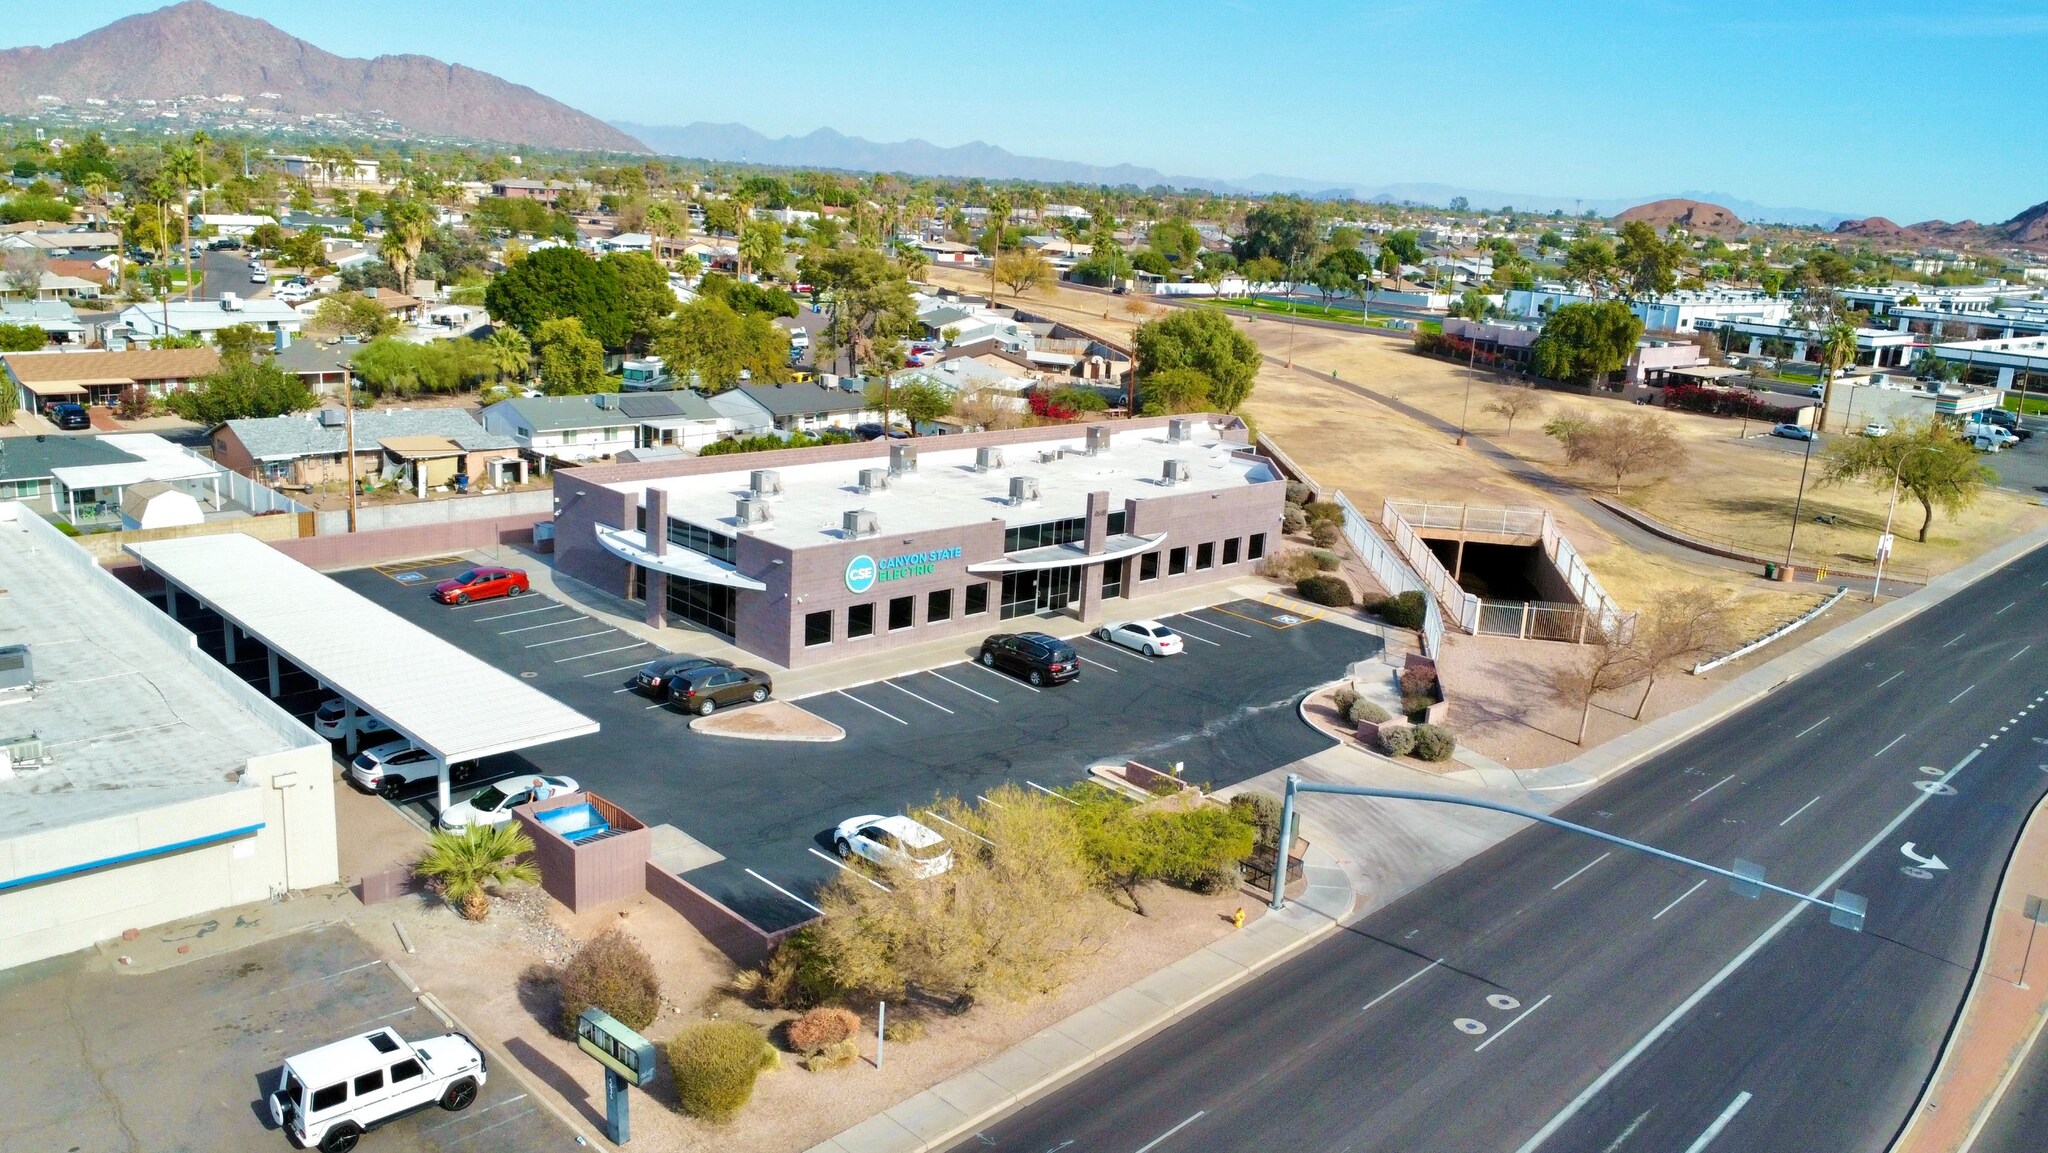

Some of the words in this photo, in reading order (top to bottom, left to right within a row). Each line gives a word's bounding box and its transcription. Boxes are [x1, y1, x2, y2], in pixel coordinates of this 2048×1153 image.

[879, 553, 927, 570] CANYON
[929, 547, 961, 561] STATE
[849, 568, 873, 581] CSE
[879, 564, 936, 582] ELECTRIC
